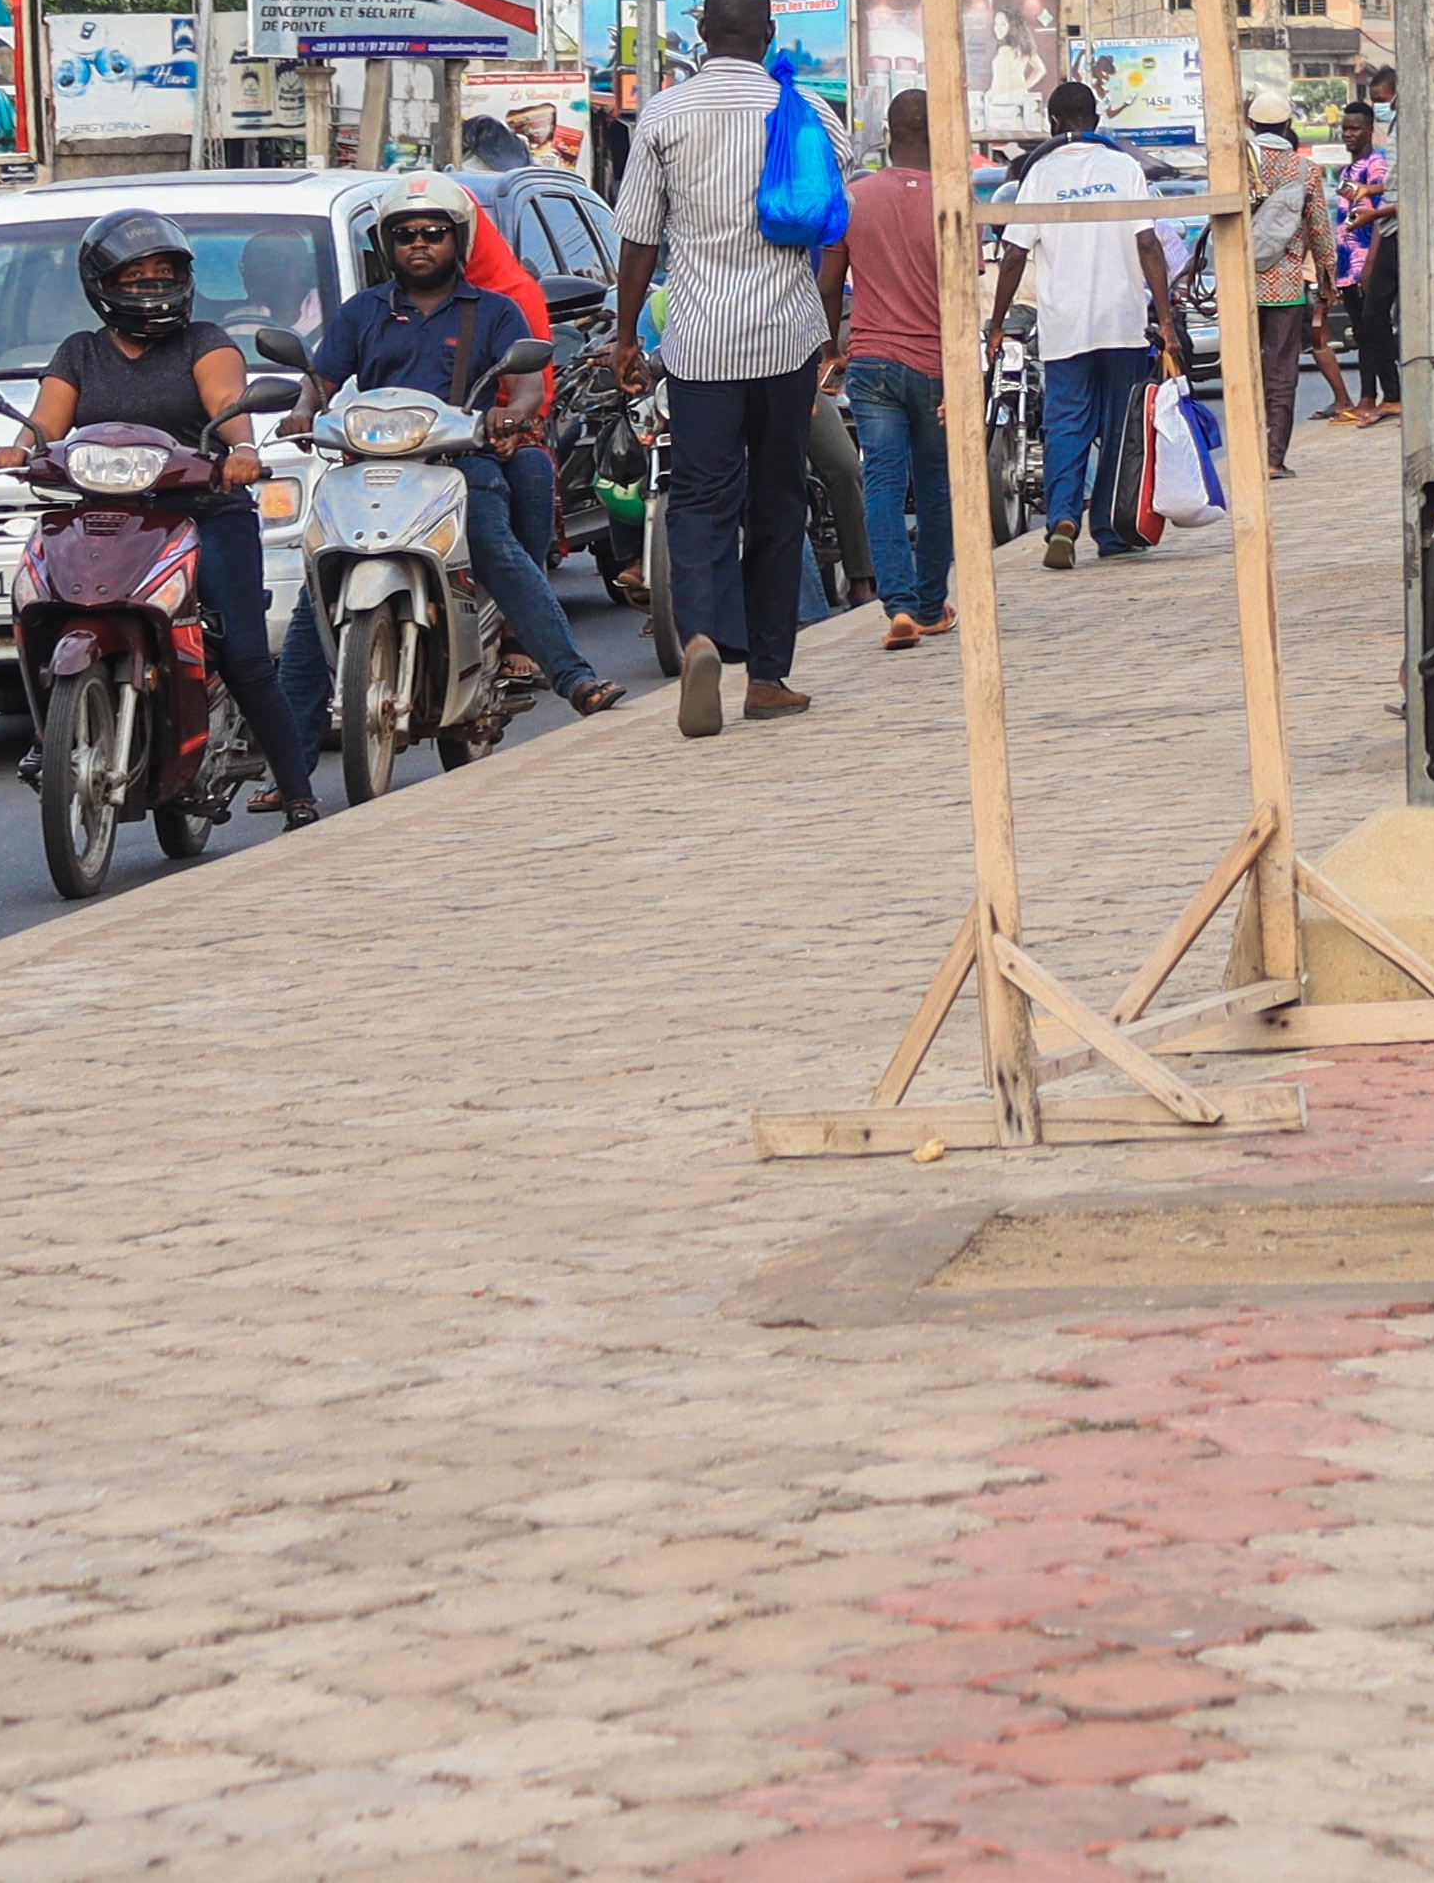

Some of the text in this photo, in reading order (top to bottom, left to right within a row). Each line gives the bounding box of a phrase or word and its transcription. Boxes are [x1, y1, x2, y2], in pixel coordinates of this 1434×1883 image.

[260, 5, 335, 18] CONCEPTION
[339, 6, 354, 17] ET
[789, 0, 802, 11] les
[261, 20, 326, 33] DE POINTE
[1056, 183, 1117, 201] SANYA
